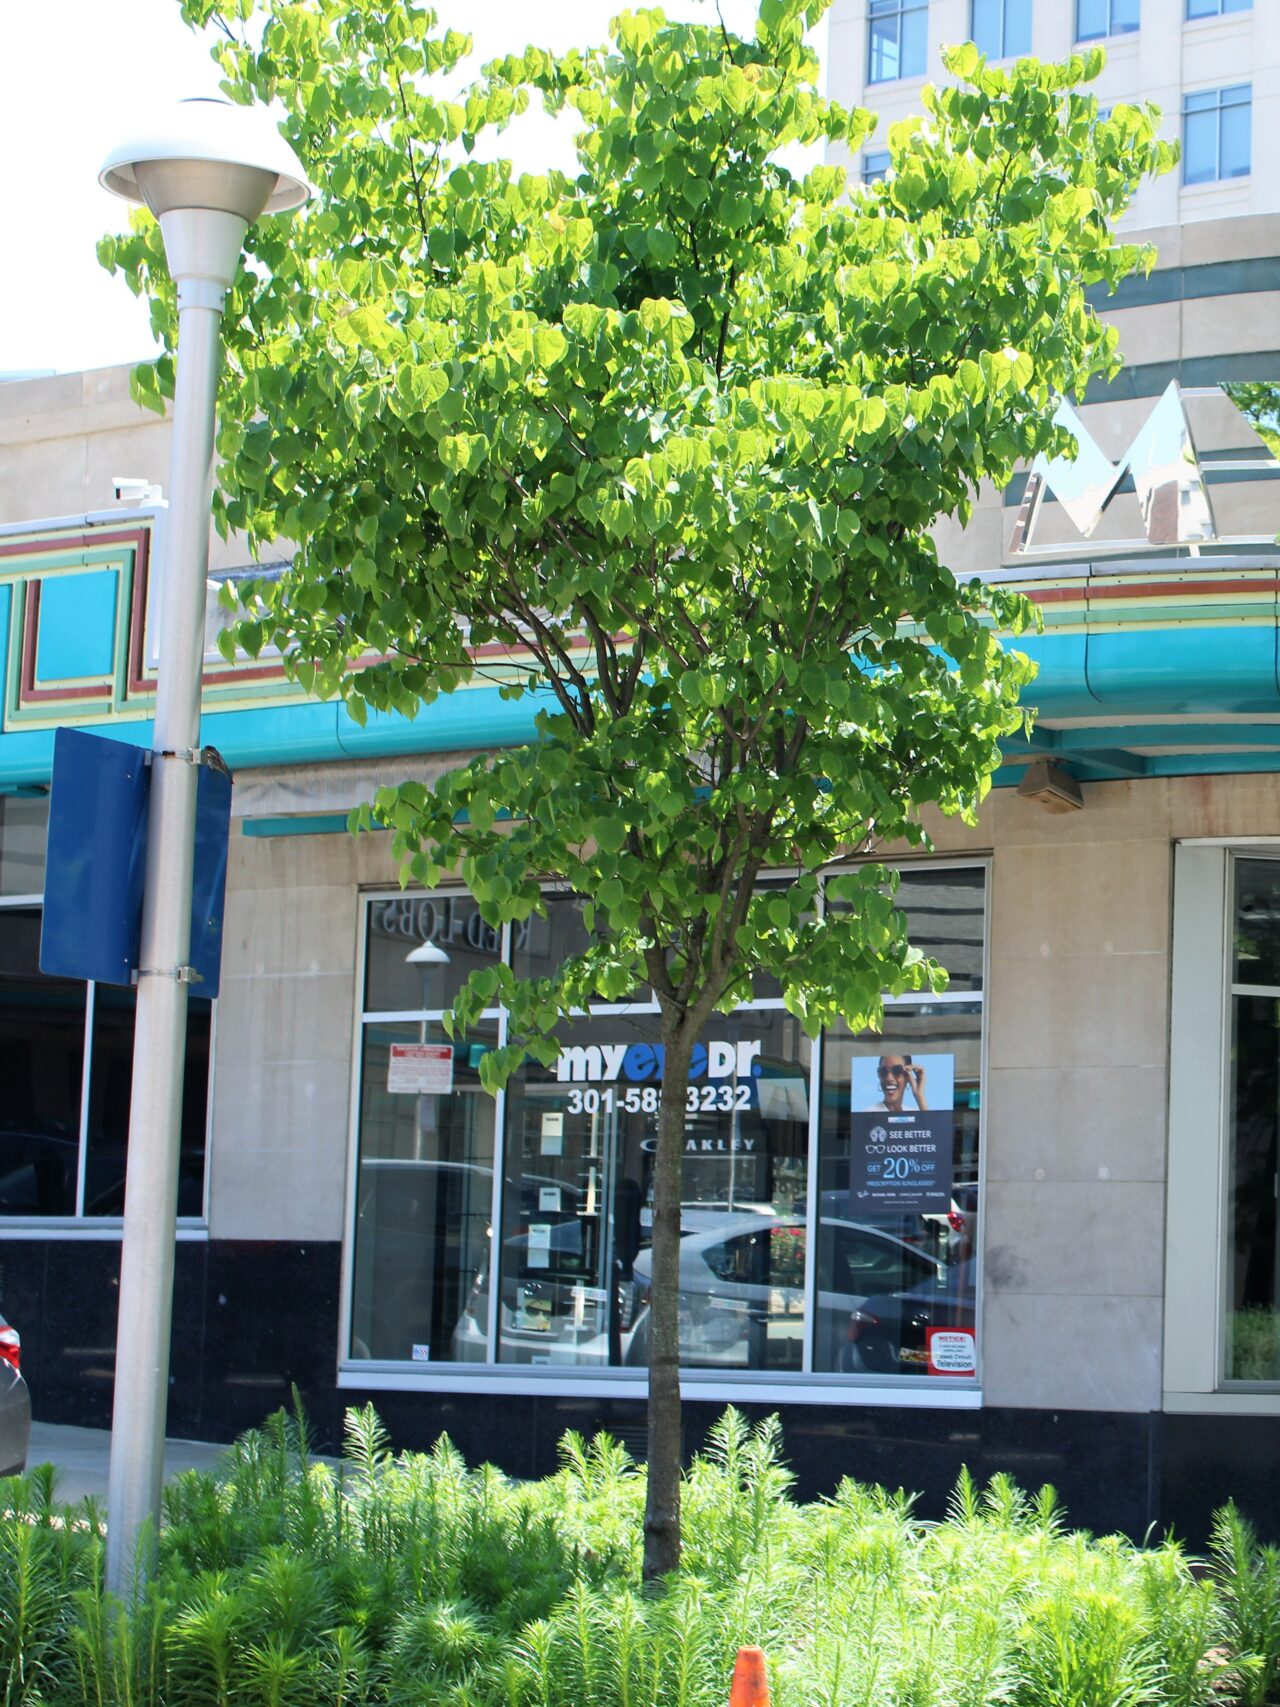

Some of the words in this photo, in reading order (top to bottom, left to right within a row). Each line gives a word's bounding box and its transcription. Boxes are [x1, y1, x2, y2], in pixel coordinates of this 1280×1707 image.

[567, 1085, 751, 1114] 301-583232
[889, 1130, 903, 1139] SEE
[904, 1130, 932, 1139] BETTER
[887, 1145, 908, 1153] LOOK
[909, 1144, 937, 1153] BETTER
[883, 1157, 920, 1178] 20%
[921, 1164, 936, 1172] OFF
